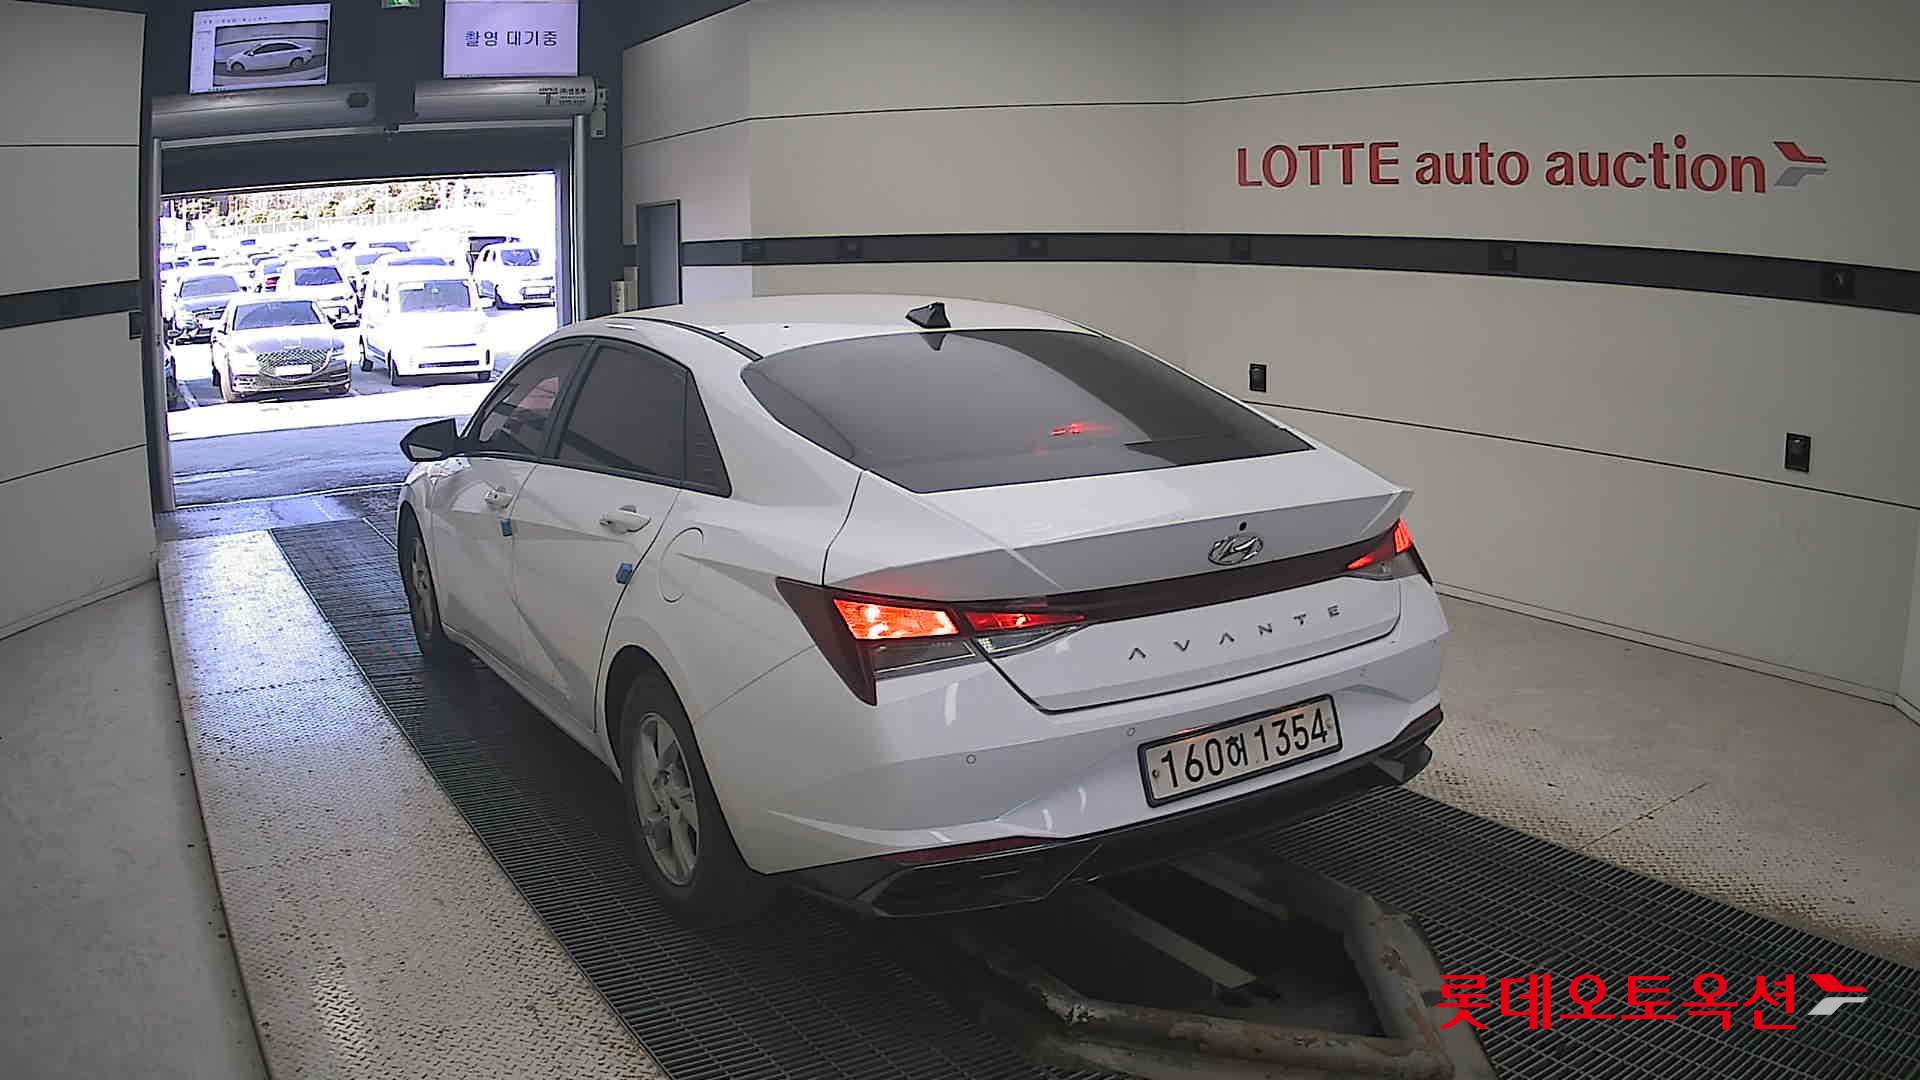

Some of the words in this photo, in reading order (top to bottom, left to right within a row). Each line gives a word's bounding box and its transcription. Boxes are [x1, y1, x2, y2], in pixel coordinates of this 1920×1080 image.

[464, 30, 498, 47] 촬영
[506, 30, 558, 47] 대기중
[1237, 141, 1400, 188] LOTTE
[1415, 142, 1529, 187] auto
[1545, 134, 1767, 194] auction
[1128, 604, 1341, 661] AVANTE
[1160, 733, 1249, 788] 160허
[1254, 708, 1328, 762] 1354
